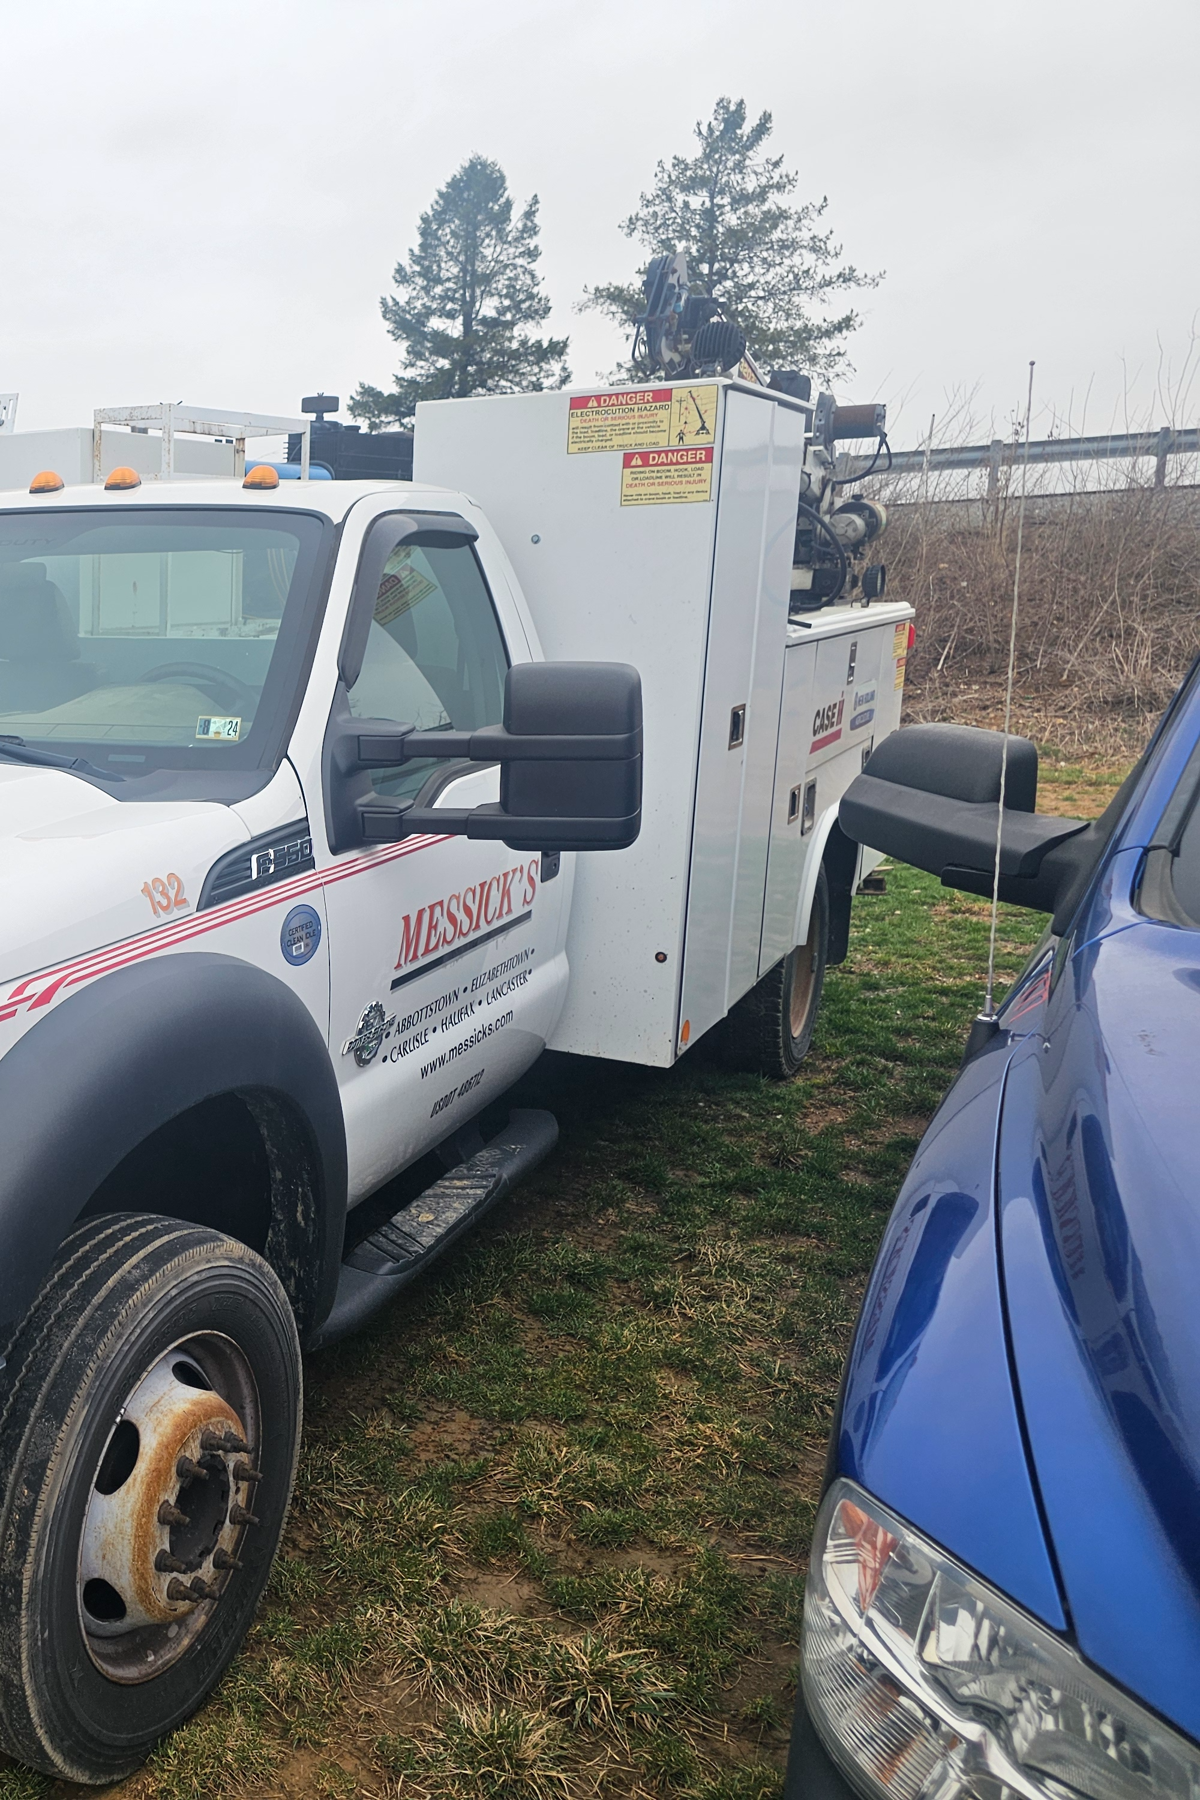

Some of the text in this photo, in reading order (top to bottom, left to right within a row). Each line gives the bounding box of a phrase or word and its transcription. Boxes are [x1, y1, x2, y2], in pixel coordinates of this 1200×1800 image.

[571, 403, 670, 418] ELECTROCUTION HAZARD
[600, 392, 653, 407] DANGER
[610, 414, 636, 422] SERIOUS
[649, 450, 706, 464] DANGER
[227, 720, 239, 737] 24
[812, 702, 838, 737] CASE
[141, 872, 189, 917] 132
[394, 858, 540, 971] MESSICK'S
[286, 928, 316, 948] CLEAN IDLE
[288, 920, 313, 937] CERTIFIED
[393, 987, 460, 1038] ABBOTTSTOWN
[470, 947, 530, 993] ELIZABETHTOWN
[390, 1027, 429, 1063] CARLISLE
[440, 1000, 476, 1033] HALIFAX
[486, 970, 529, 1006] LANCASTER
[420, 1010, 514, 1080] www.messicks.com
[430, 1087, 459, 1118] USDOT
